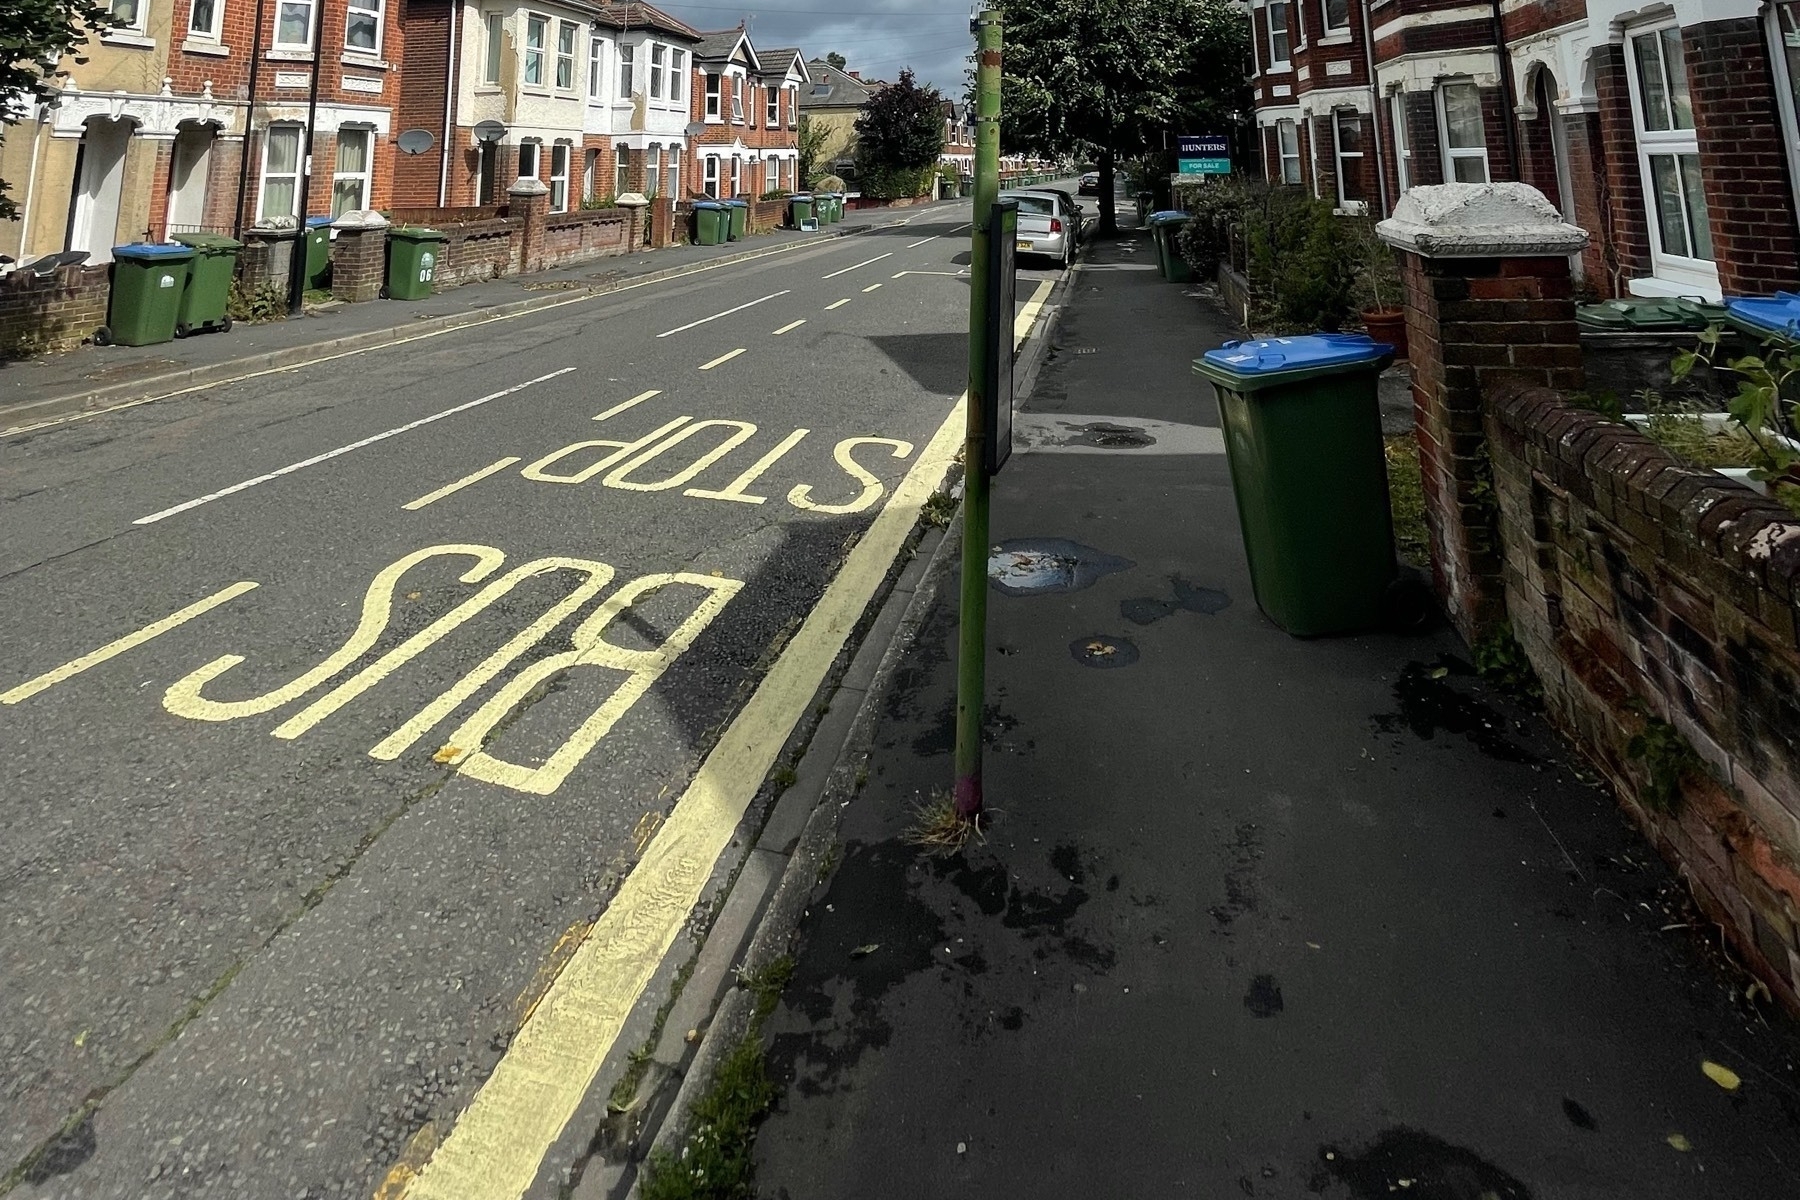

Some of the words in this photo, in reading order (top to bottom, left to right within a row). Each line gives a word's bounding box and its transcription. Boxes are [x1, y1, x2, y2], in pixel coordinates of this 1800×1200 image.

[420, 269, 432, 282] 06
[520, 415, 912, 514] STOP
[163, 543, 745, 795] BUS
